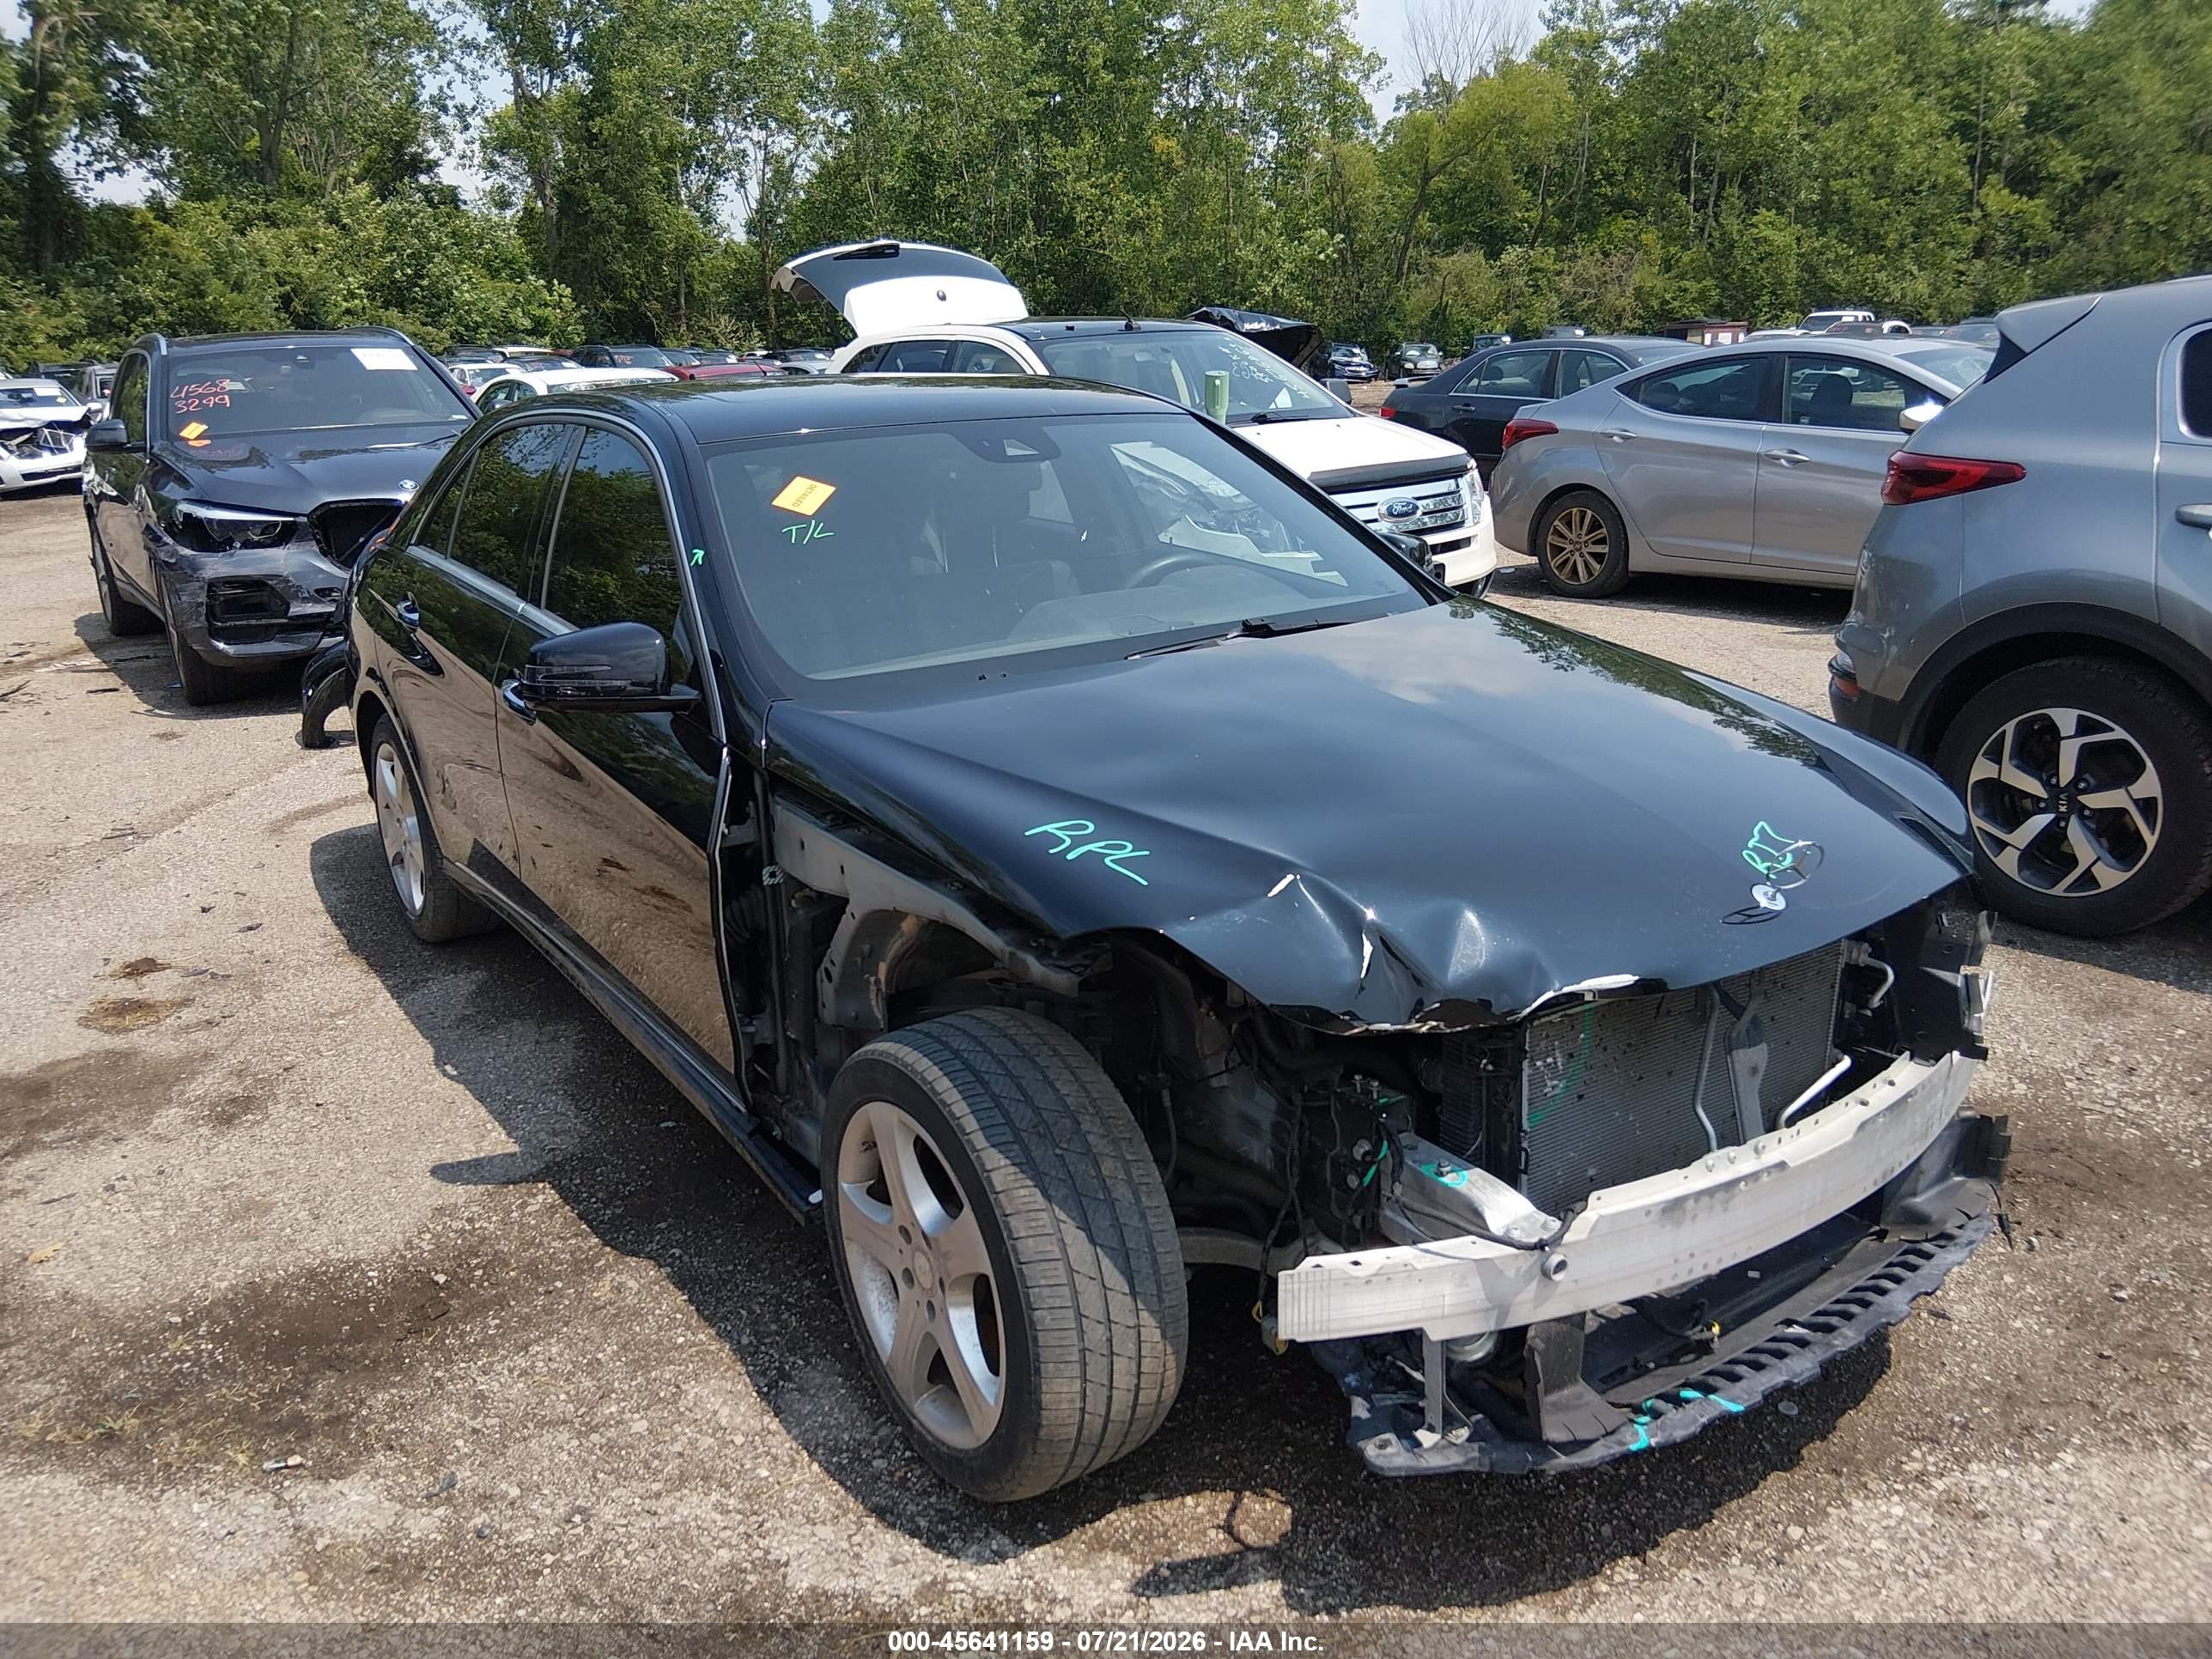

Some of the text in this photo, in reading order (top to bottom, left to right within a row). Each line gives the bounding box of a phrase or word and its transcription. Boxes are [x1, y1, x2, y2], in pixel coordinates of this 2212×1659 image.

[169, 379, 231, 398] 4568
[173, 395, 230, 414] 3299
[793, 483, 817, 507] DETAILED
[1391, 501, 1413, 515] Ford
[2057, 793, 2069, 812] KIA
